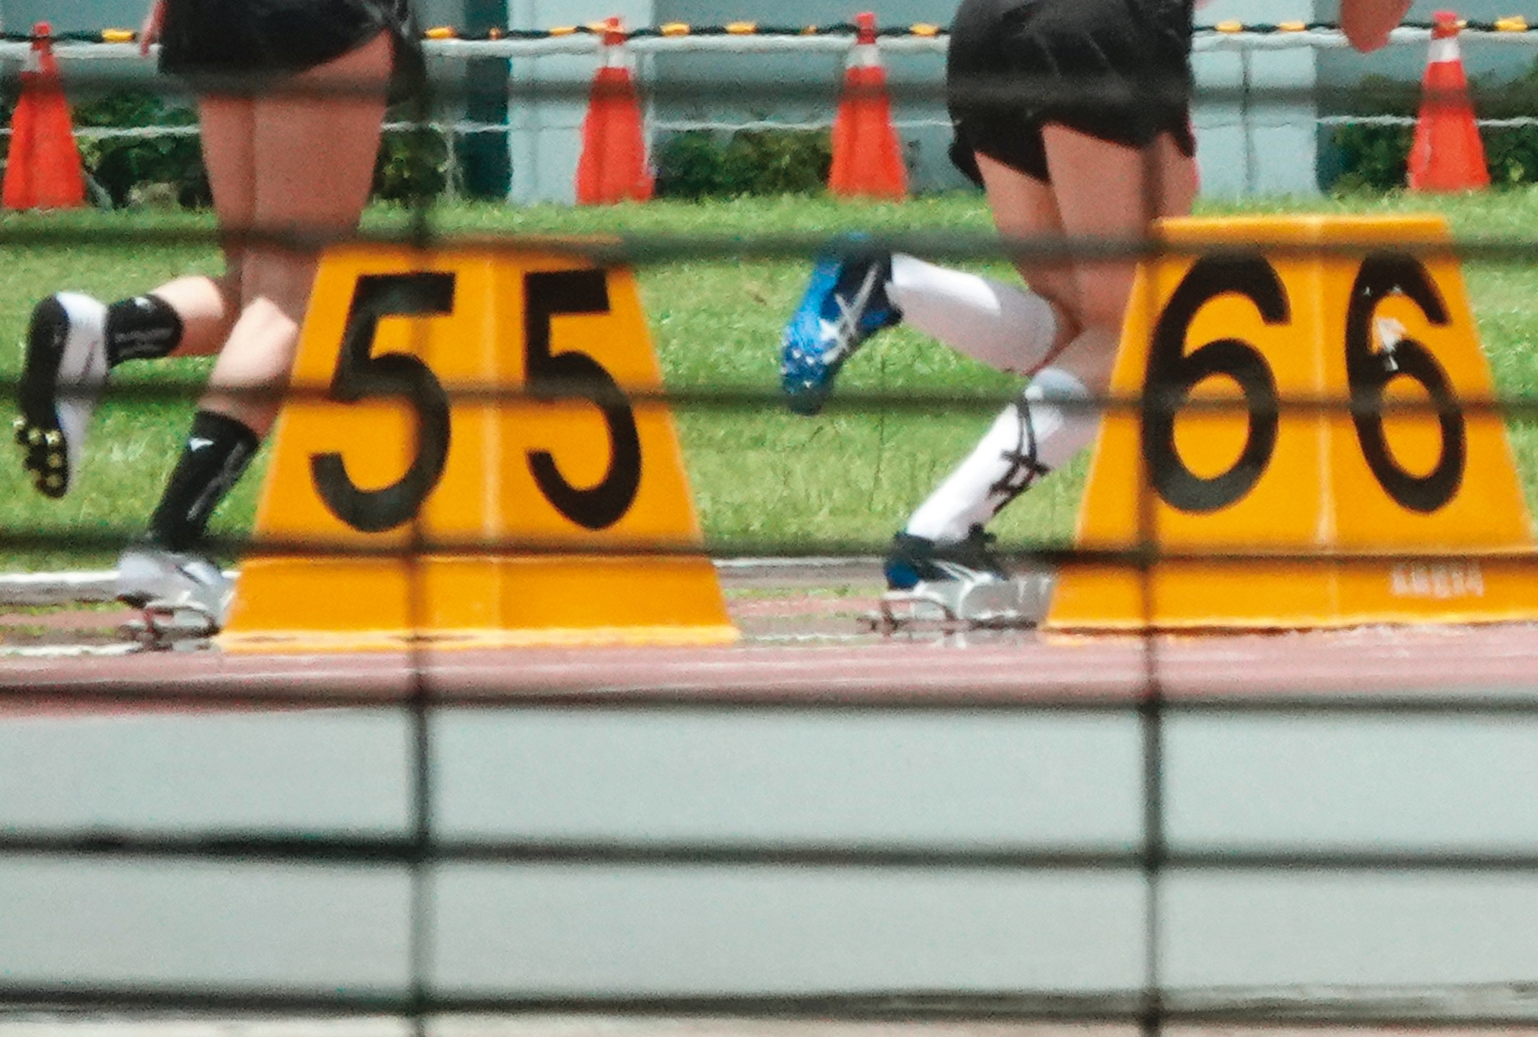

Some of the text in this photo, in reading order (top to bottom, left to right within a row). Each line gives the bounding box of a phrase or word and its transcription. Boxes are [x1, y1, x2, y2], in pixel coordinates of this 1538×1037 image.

[309, 271, 456, 534] 5
[523, 267, 643, 532] 5
[1142, 247, 1291, 516] 6
[1345, 247, 1468, 516] 6
